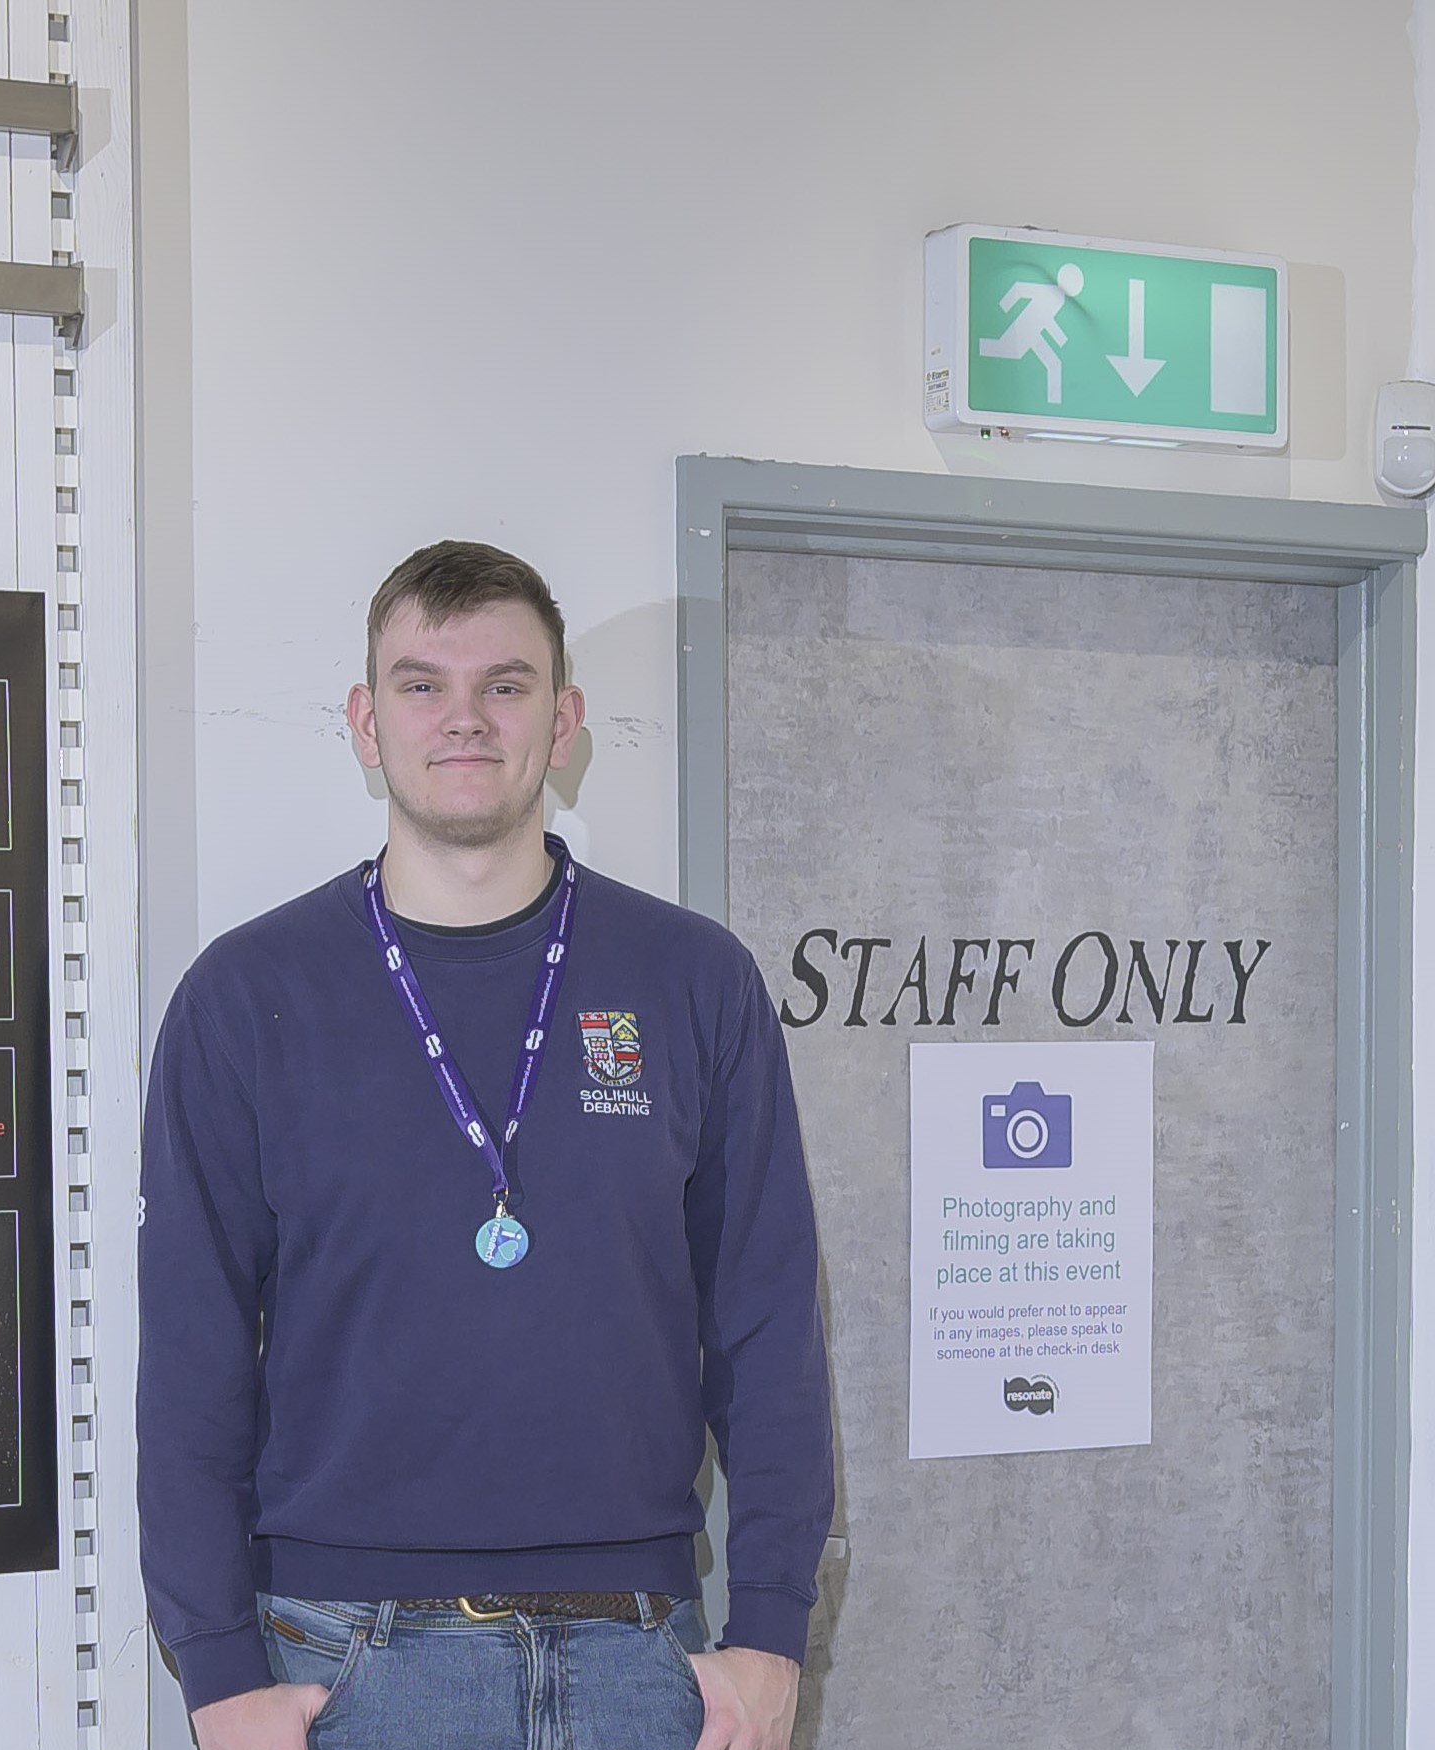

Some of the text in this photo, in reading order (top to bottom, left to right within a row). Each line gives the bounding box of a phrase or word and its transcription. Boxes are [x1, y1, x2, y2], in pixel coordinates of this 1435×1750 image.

[780, 928, 1271, 1028] STAFF ONLY
[580, 1089, 652, 1104] SOLIHULL
[583, 1102, 650, 1116] DEBATING
[944, 1195, 1115, 1222] Photography and
[943, 1228, 1114, 1254] filming are taking
[938, 1260, 1120, 1289] place at this event
[930, 1304, 1127, 1322] If you would prefer not to appear
[934, 1330, 944, 1340] in
[949, 1330, 972, 1342] any
[1028, 1324, 1067, 1340] please
[1072, 1322, 1107, 1338] speak
[1112, 1322, 1122, 1334] to
[937, 1341, 1119, 1359] someone at the check-in desk
